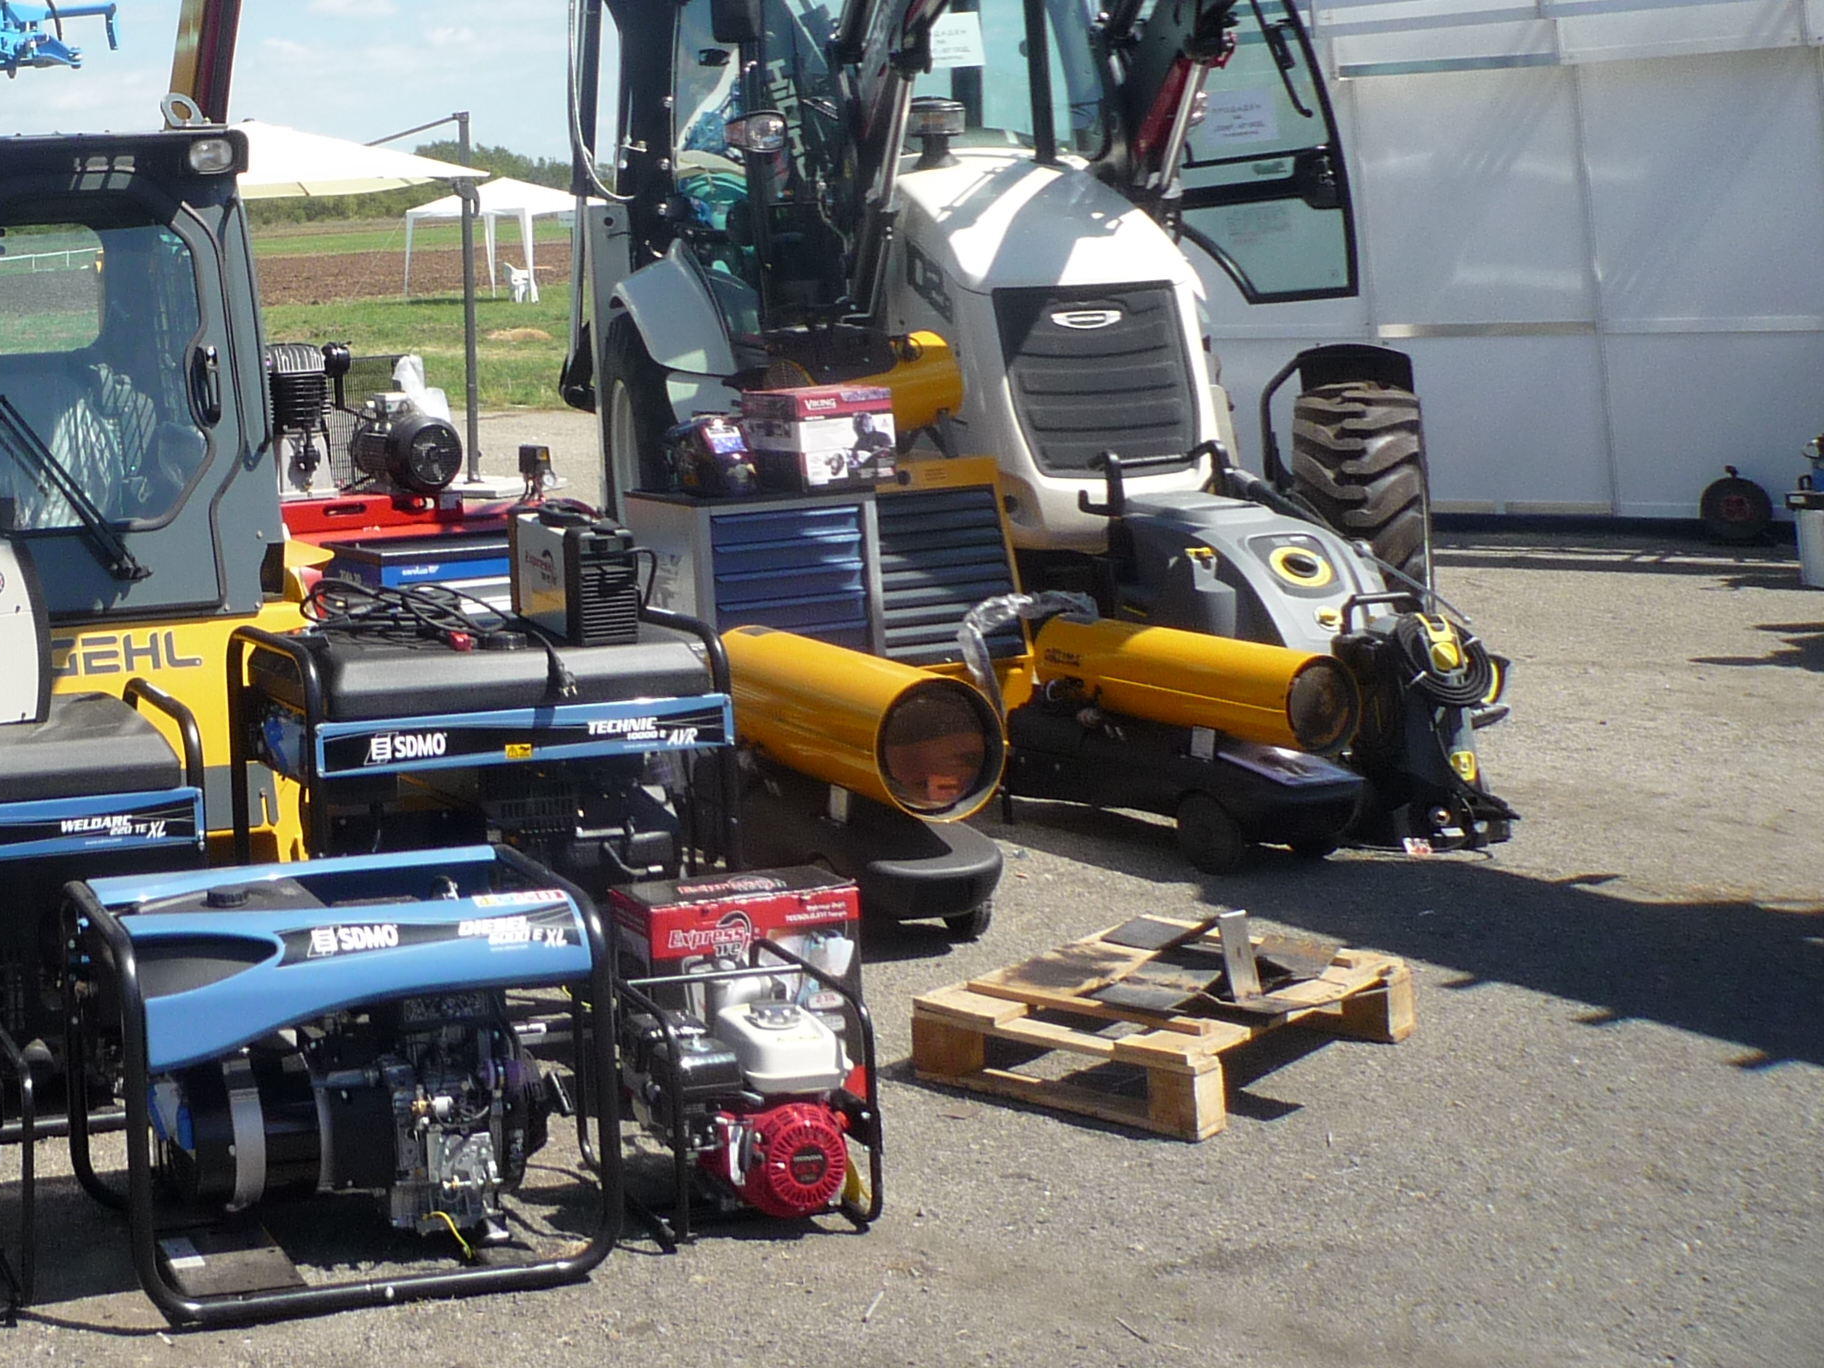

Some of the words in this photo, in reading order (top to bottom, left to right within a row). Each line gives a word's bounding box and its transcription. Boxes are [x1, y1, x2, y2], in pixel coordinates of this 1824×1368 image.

[587, 717, 658, 735] TECHNIC
[394, 733, 446, 758] SDMO
[667, 727, 698, 746] AVR
[60, 815, 133, 835] WELDARC
[146, 820, 167, 839] XL
[458, 916, 527, 936] DIESEL
[339, 925, 399, 951] SDMO
[532, 928, 543, 941] E
[544, 927, 568, 947] XL
[668, 925, 745, 951] Express
